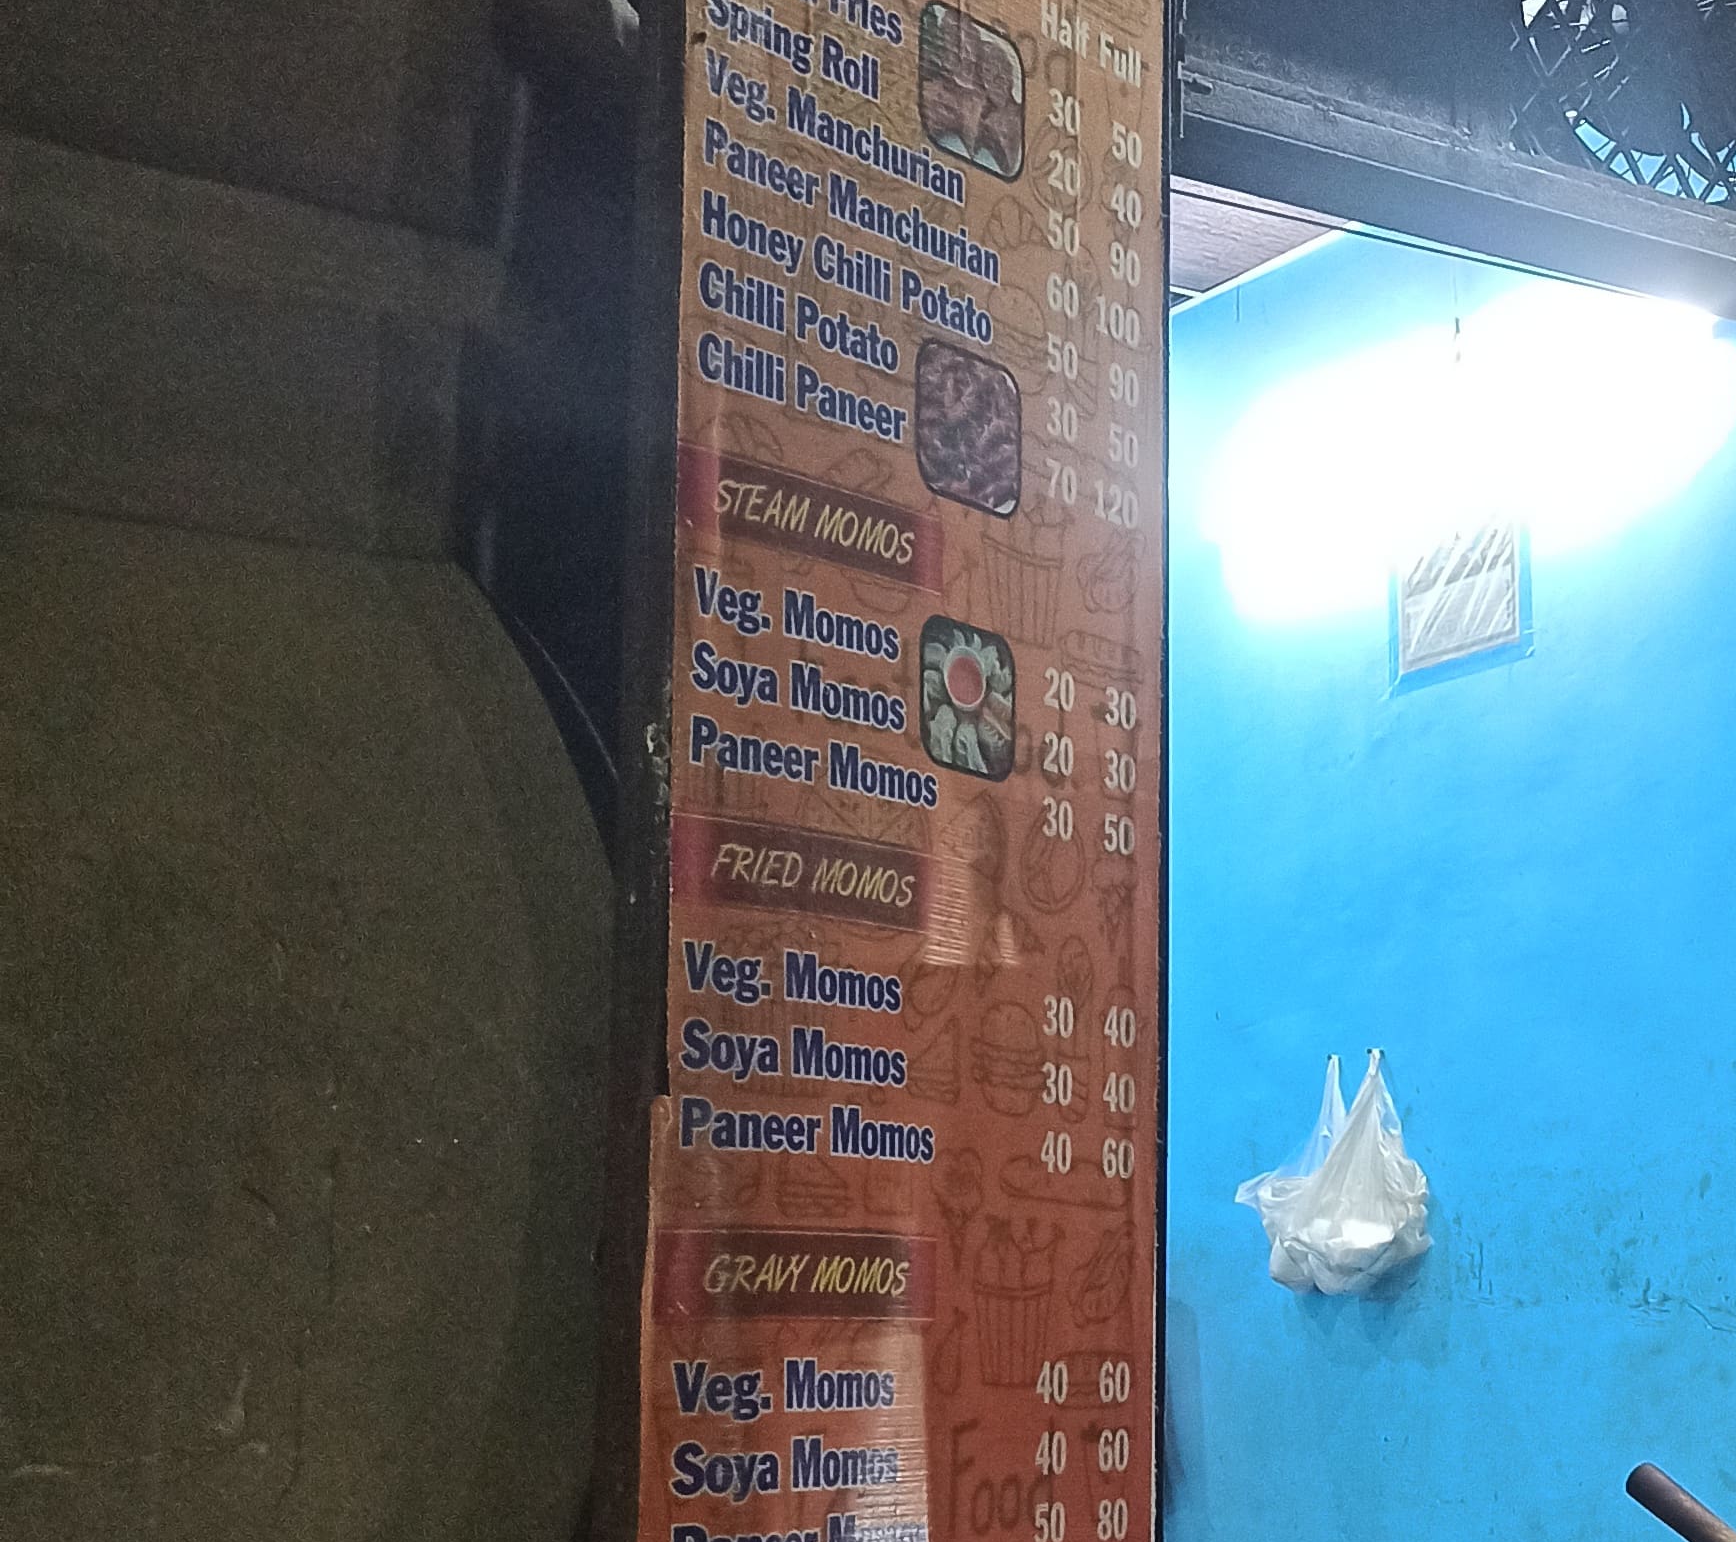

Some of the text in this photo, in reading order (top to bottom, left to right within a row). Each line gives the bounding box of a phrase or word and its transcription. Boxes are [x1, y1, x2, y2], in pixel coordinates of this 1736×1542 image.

[821, 35, 881, 102] Roll
[1098, 26, 1143, 88] Full
[705, 47, 967, 206] Veg. Manchurian
[1047, 88, 1142, 166] 30 50
[703, 116, 1000, 285] Paneer Manchurian
[1046, 149, 1142, 229] 20 40
[701, 189, 994, 345] Honey Chilli Potato
[1046, 209, 1142, 288] 50 90
[698, 260, 900, 374] Chilli Potato
[1046, 273, 1141, 346] 60 100
[697, 332, 908, 443] Chilli Paneer
[713, 478, 915, 566] STEAM MOMOS
[1045, 458, 1140, 530] 70 120
[693, 565, 901, 661] Veg. Momos
[691, 639, 908, 734] Soya Momos
[1043, 667, 1137, 732] 20 30
[689, 714, 939, 810] Paneer Momos
[711, 842, 916, 909] FRIED MOMOS
[682, 939, 903, 1014] Veg. Momos
[680, 1017, 908, 1089] Soya Momos
[679, 1096, 936, 1166] Paneer Momos
[1040, 1130, 1136, 1180] 40 60
[703, 1253, 911, 1299] GRAVY MOMOS
[671, 1357, 897, 1422] Veg. Momos
[670, 1438, 780, 1505] Soya
